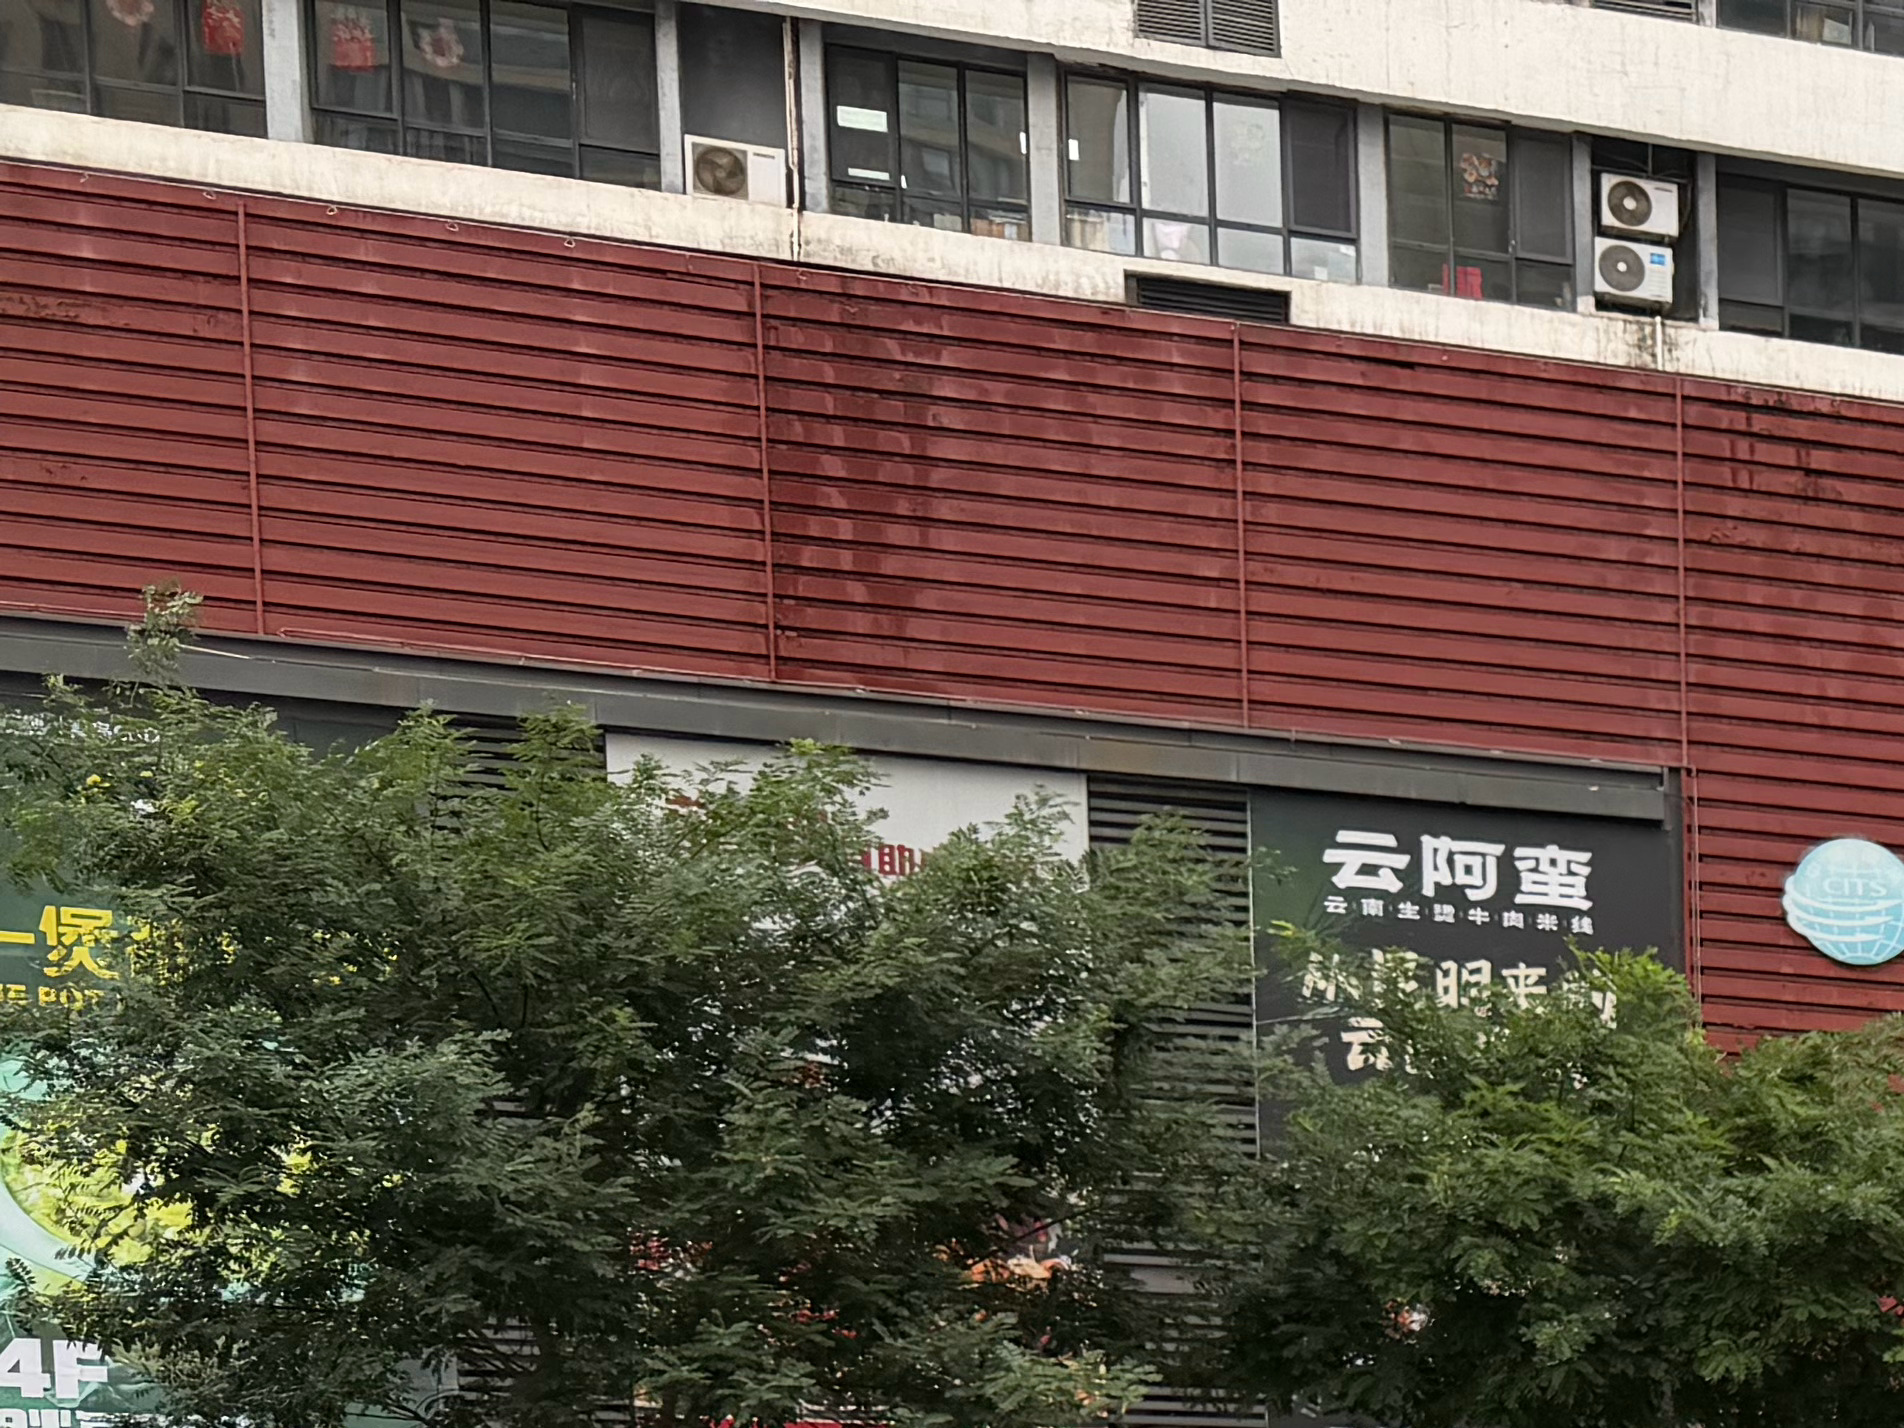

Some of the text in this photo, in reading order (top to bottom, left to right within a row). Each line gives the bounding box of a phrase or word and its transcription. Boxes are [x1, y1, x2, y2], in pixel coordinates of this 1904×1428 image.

[1322, 829, 1594, 911] 云阿蛮
[1822, 878, 1888, 897] CITS
